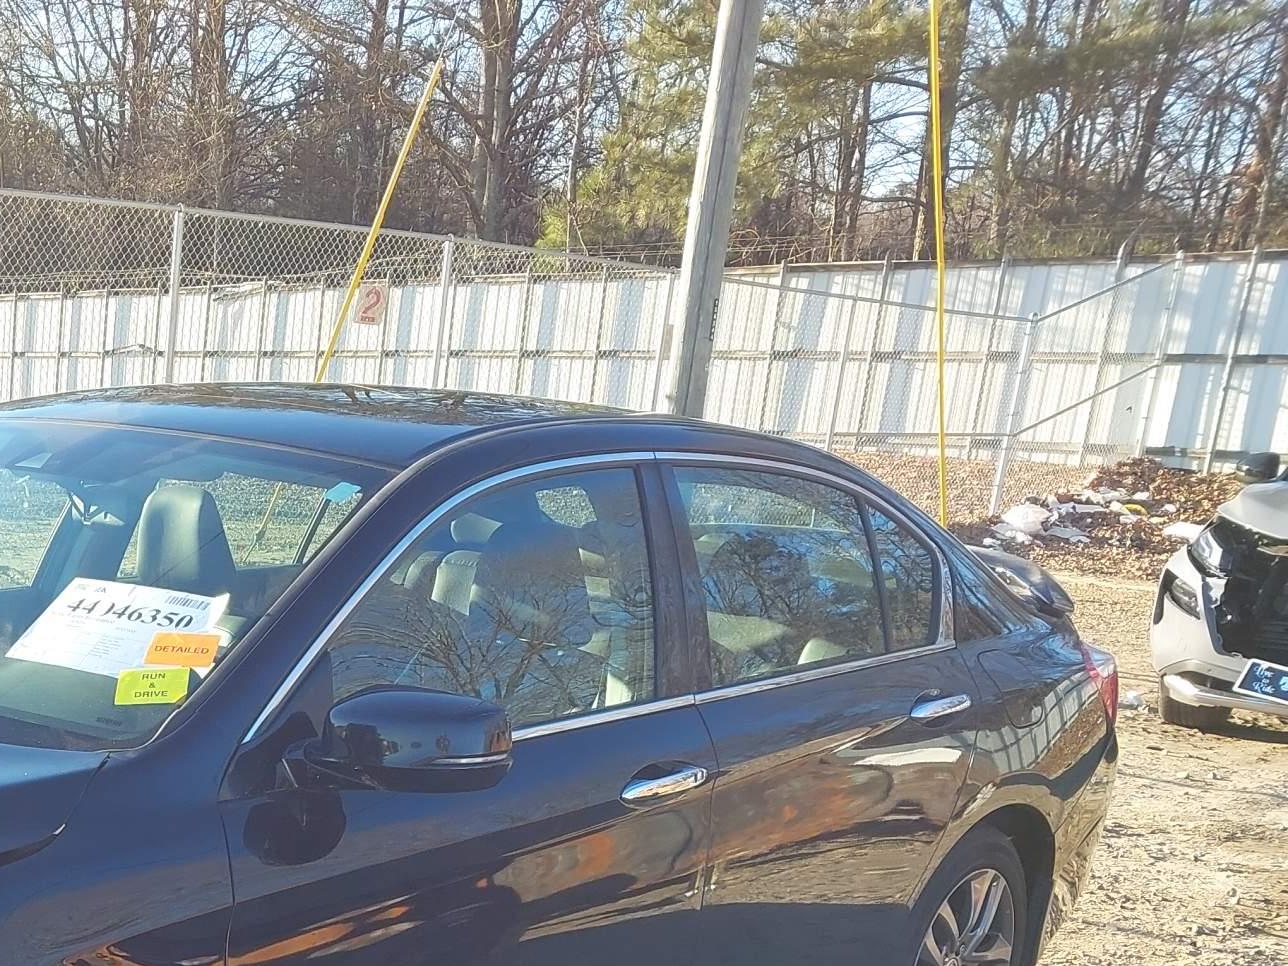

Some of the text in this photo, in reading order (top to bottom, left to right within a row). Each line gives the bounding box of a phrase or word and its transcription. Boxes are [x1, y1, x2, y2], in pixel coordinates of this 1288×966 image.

[154, 645, 210, 655] DETAILED
[142, 672, 166, 680] RUN
[134, 690, 169, 698] DRIVE
